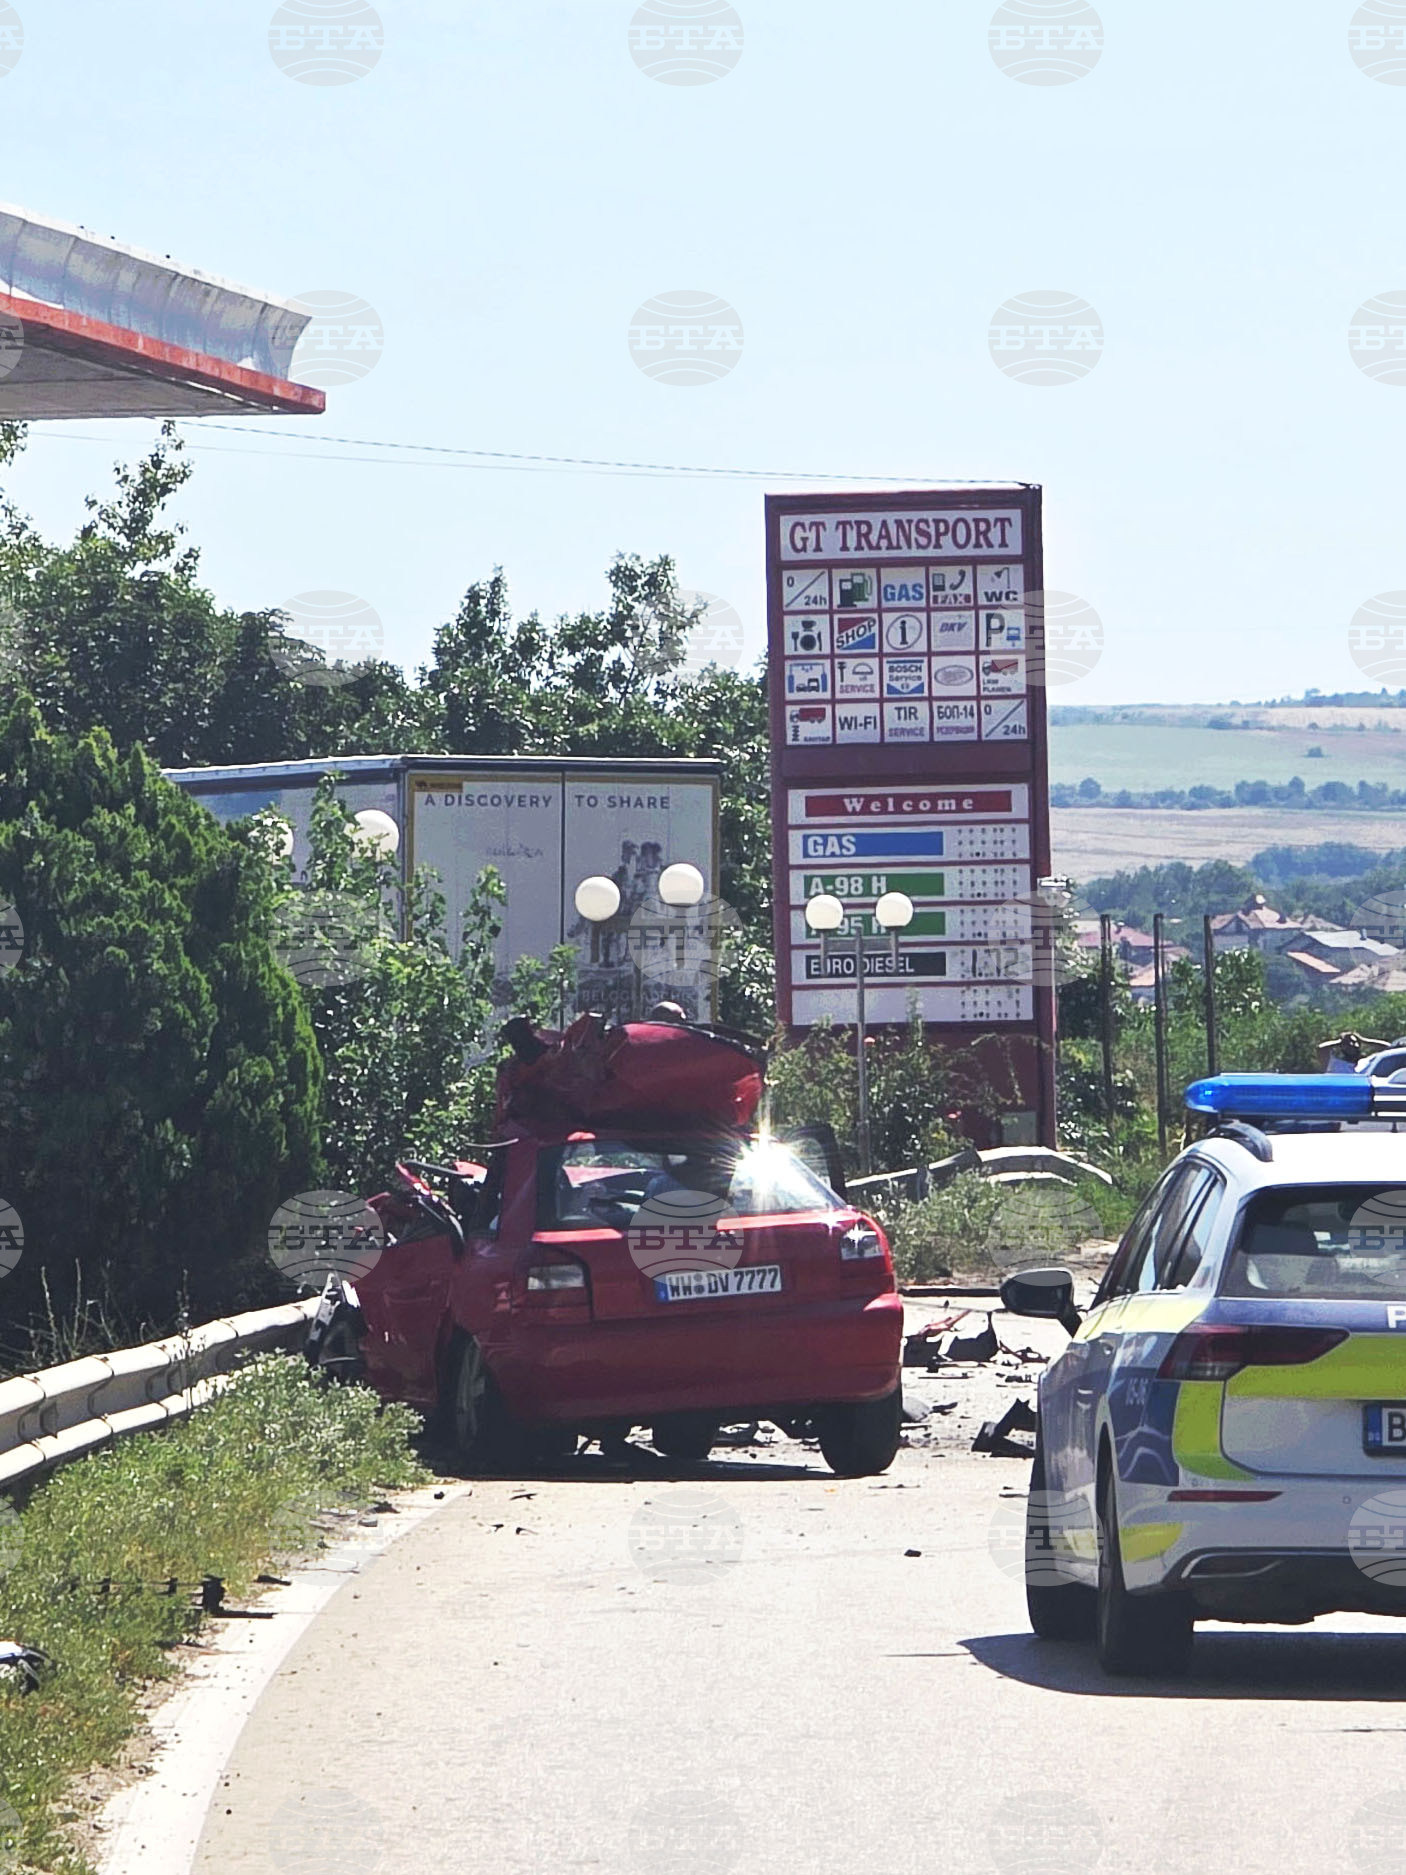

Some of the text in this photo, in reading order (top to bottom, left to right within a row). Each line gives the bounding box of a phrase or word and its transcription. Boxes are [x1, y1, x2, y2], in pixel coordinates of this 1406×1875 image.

[789, 517, 1012, 554] GT TRANSPORT
[883, 583, 924, 603] GAS
[984, 590, 1019, 603] WC
[836, 618, 877, 651] SHOP
[888, 664, 923, 674] BOSCH
[894, 706, 919, 722] TIR
[838, 715, 877, 732] WI-FI
[425, 794, 671, 810] A DISCOVERY TO SHARE
[843, 797, 974, 812] Welcome
[807, 835, 857, 856] GAS
[809, 875, 887, 896] A-98 H
[707, 1271, 729, 1294] DV
[734, 1267, 779, 1293] 7777
